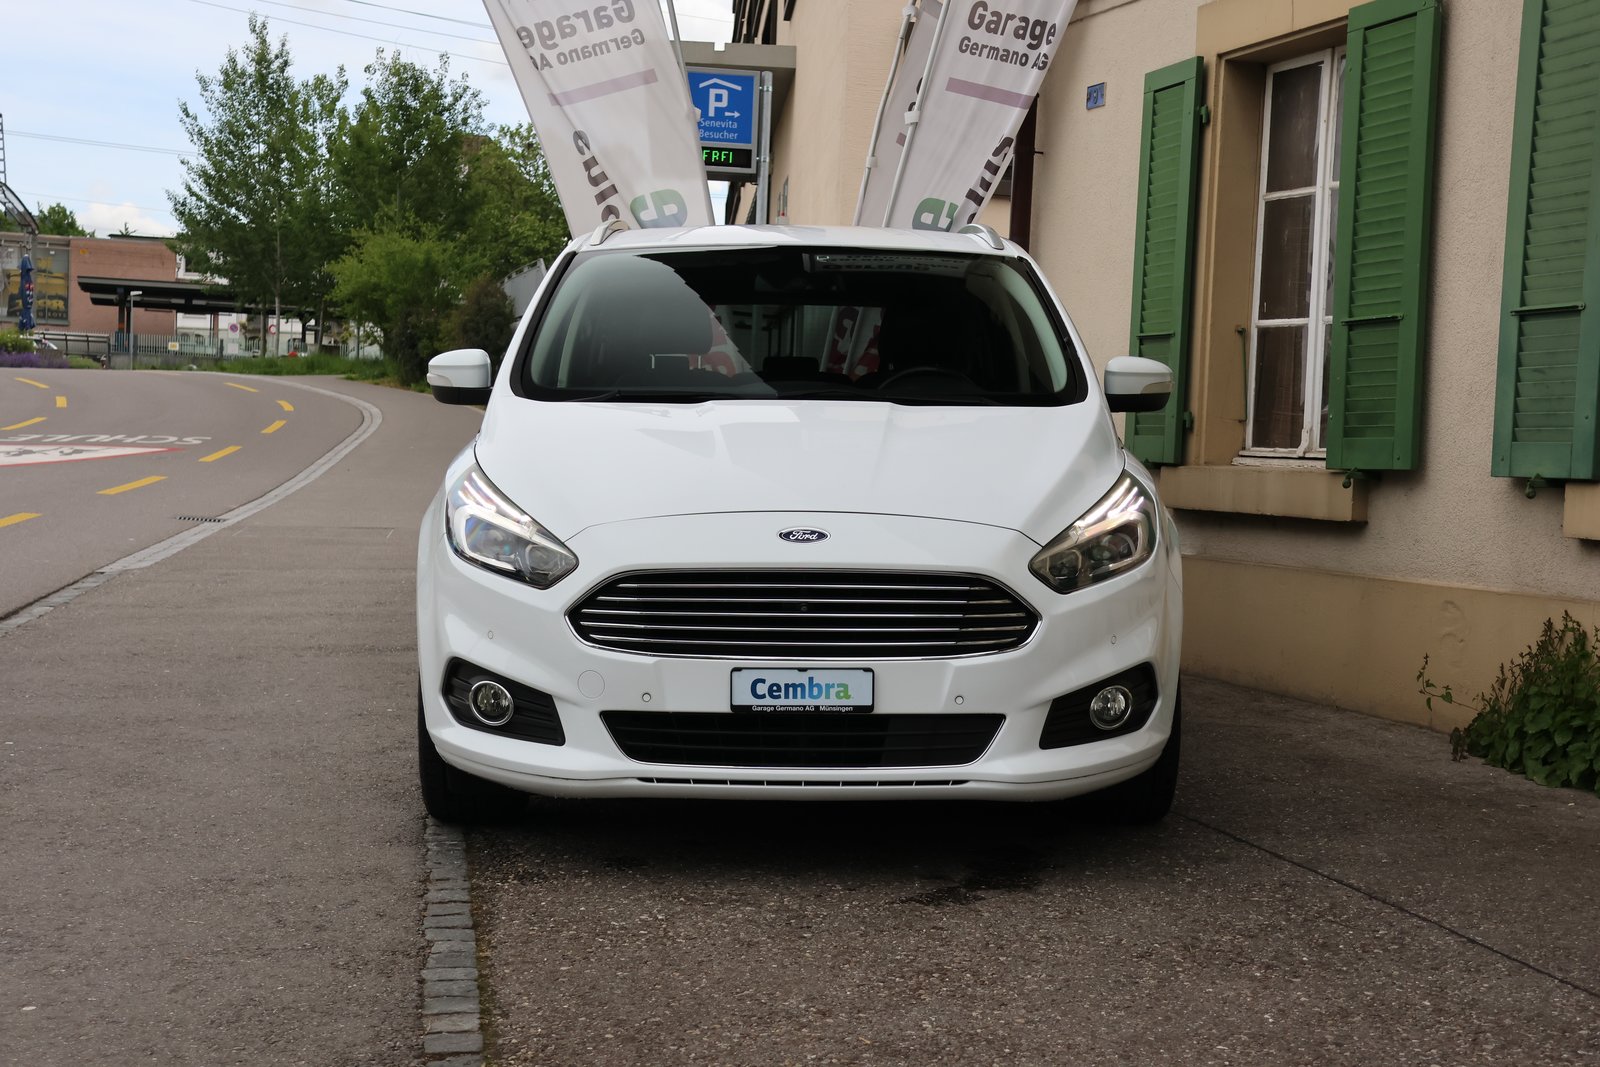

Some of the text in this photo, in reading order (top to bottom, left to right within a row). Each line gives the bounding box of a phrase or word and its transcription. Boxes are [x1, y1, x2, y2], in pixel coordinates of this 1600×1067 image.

[967, 0, 1057, 51] Garage
[958, 36, 1049, 71] Germano AG
[708, 88, 728, 117] P
[700, 117, 738, 129] Senevita
[699, 128, 738, 140] Besucher
[0, 433, 212, 445] SCHULE
[789, 529, 819, 540] Ford
[750, 676, 852, 701] Cembra
[752, 705, 774, 713] Garage
[819, 704, 853, 713] Münsingen
